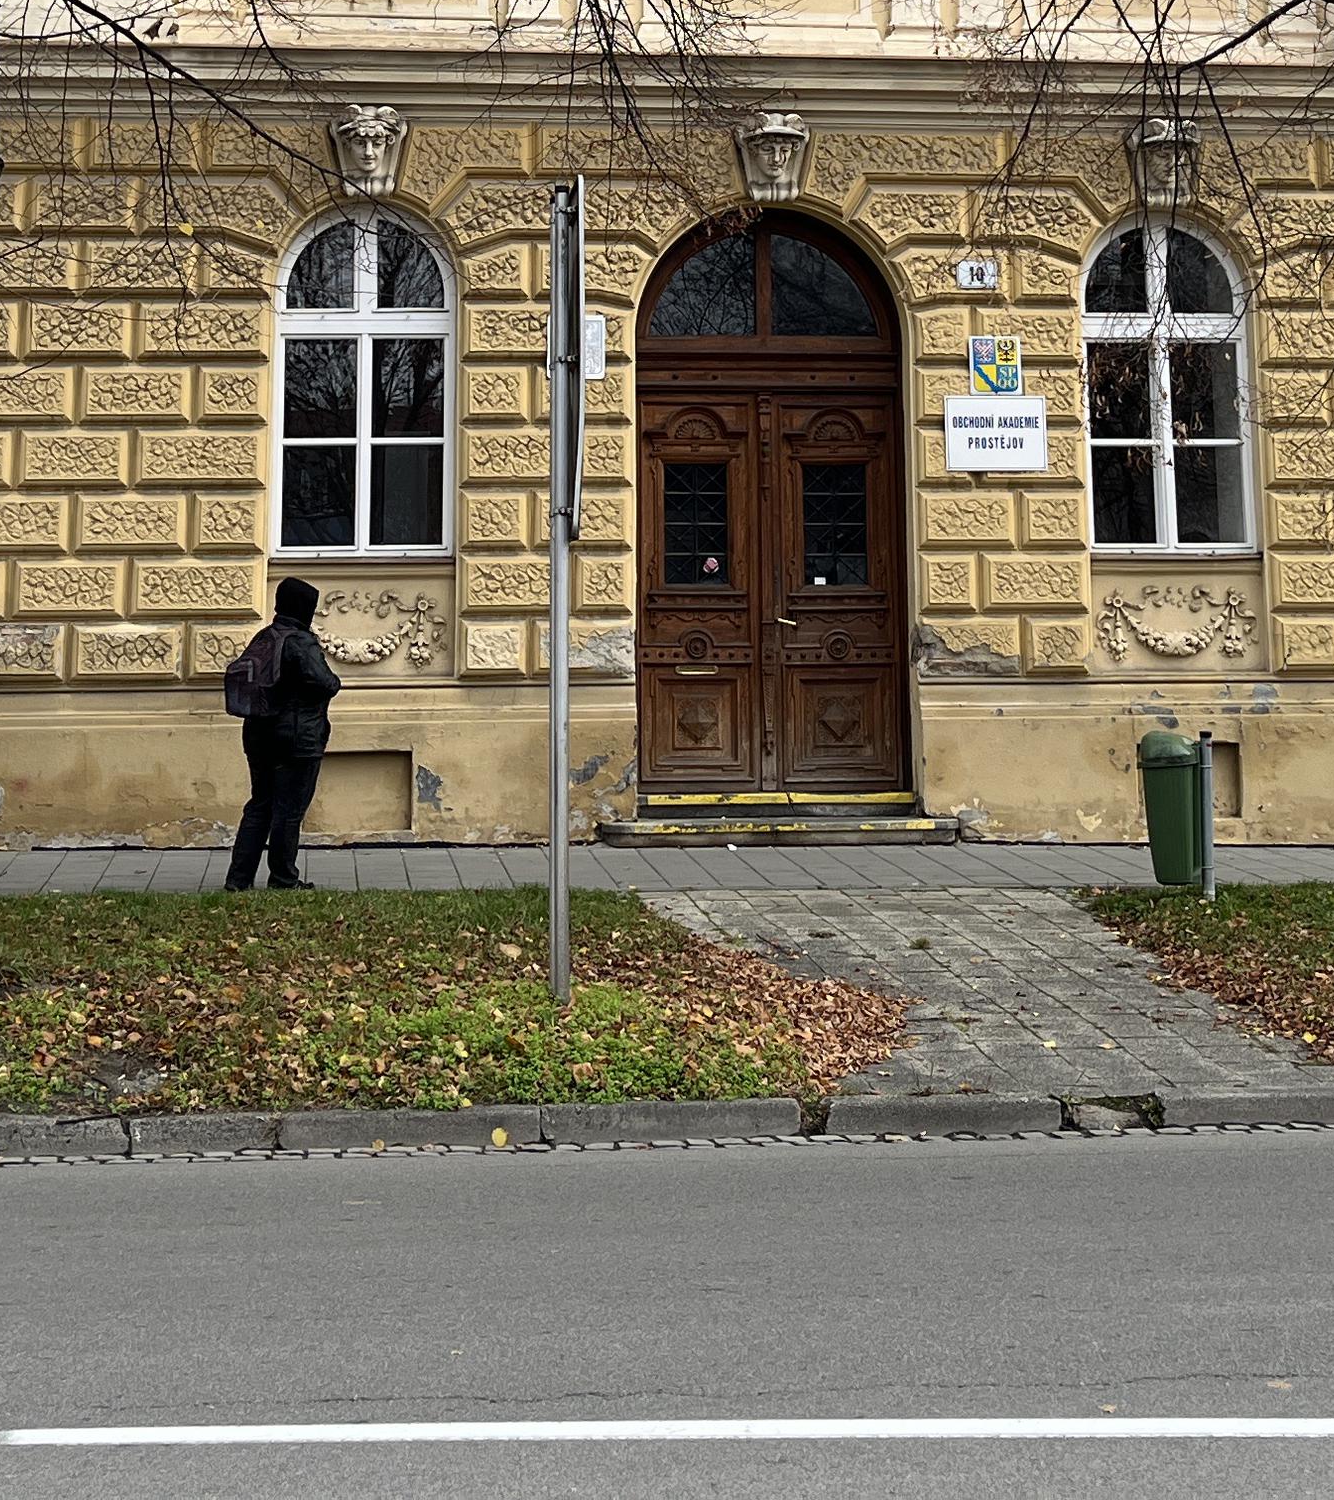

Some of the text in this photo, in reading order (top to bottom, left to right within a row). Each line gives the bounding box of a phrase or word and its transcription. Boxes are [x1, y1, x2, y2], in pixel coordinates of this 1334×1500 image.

[969, 266, 986, 282] 10
[999, 366, 1017, 378] SP
[952, 414, 1040, 429] OBCHODNÍ AKADEMIE
[968, 435, 1024, 449] PROSTĚJOV
